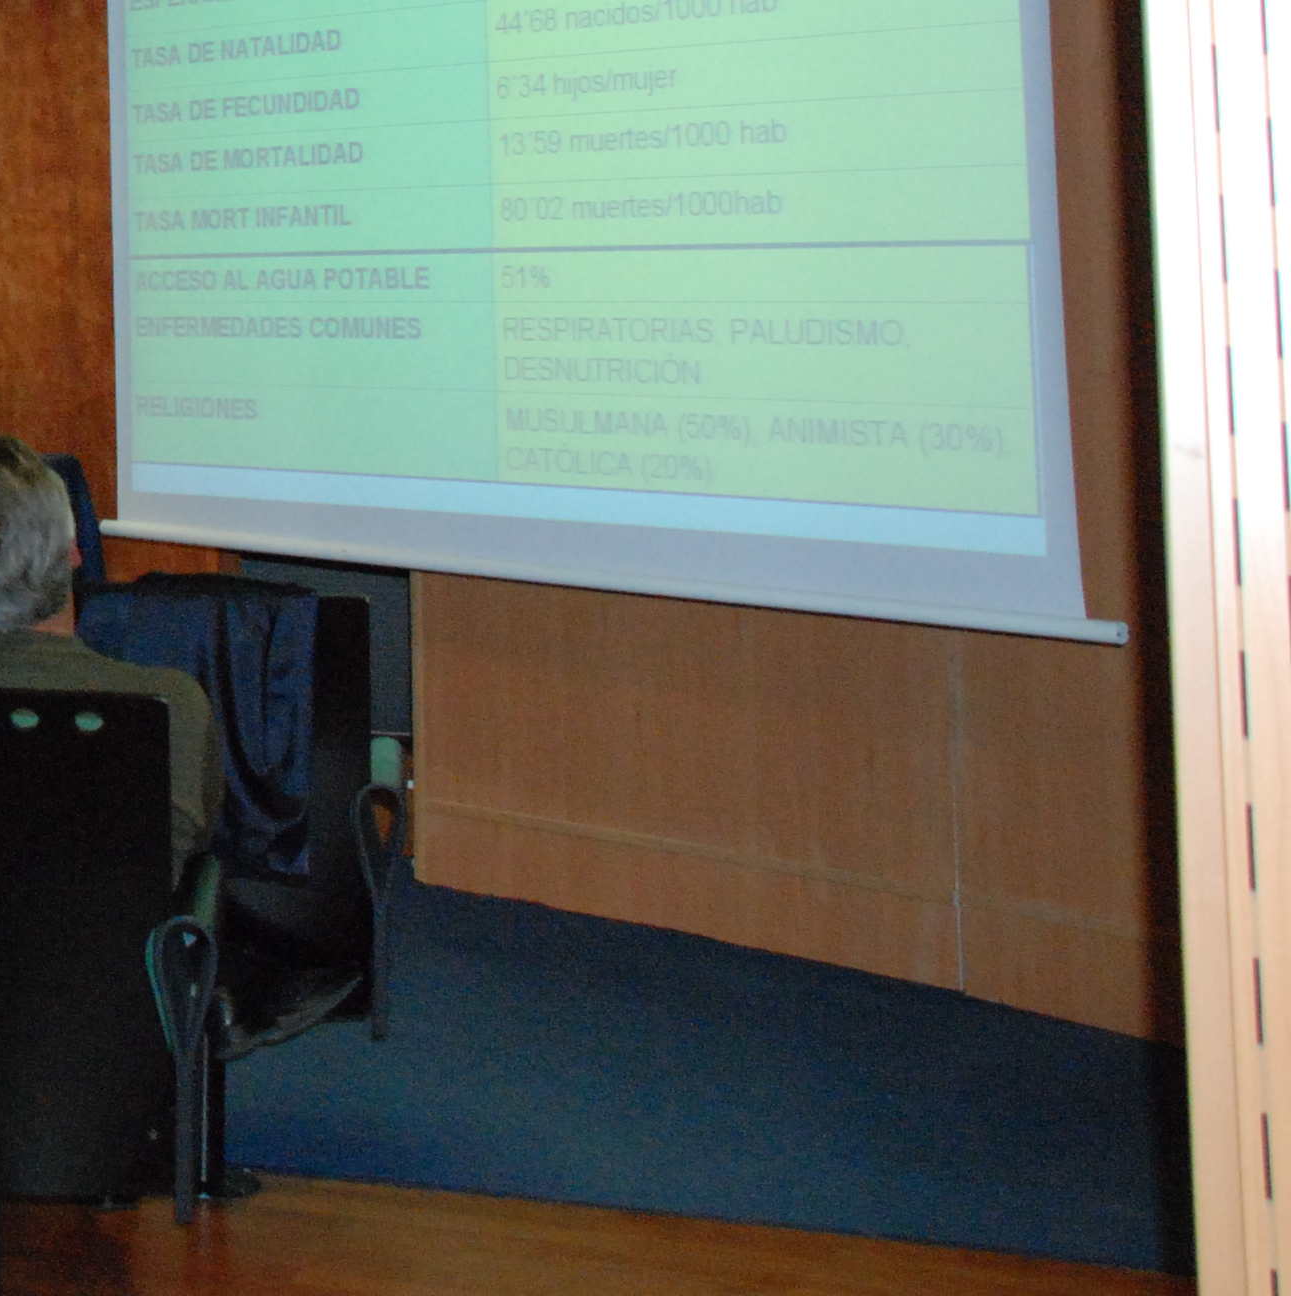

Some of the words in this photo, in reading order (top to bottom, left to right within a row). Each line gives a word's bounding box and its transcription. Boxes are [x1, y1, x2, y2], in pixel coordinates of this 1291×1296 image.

[131, 45, 182, 68] TASA
[188, 41, 216, 64] DE
[220, 29, 341, 60] NATALIDAD
[553, 65, 677, 101] hijos/mujer
[132, 102, 183, 124] TASA
[189, 98, 217, 121] DE
[222, 87, 360, 118] FECUNDIDAD
[740, 118, 786, 145] hab
[133, 152, 183, 175] TASA
[190, 150, 218, 172] DE
[223, 141, 364, 170] MORTALIDAD
[133, 210, 185, 232] TASA
[256, 204, 352, 228] INFANTIL
[135, 270, 216, 291] ACCESO
[223, 269, 249, 290] AL
[256, 268, 317, 290] AGUA
[324, 266, 430, 290] POTABLE
[501, 265, 550, 289] 51%
[135, 316, 303, 338] ENFERMEDADES
[309, 316, 422, 339] COMUNES
[504, 353, 701, 384] DESNUTRICIÓN
[136, 395, 258, 420] RELIGIONES
[506, 407, 668, 437] MUSULMANA
[769, 417, 908, 447] ANIMISTA
[505, 442, 633, 476] CATÓLICA
[641, 454, 713, 487] (20%)
